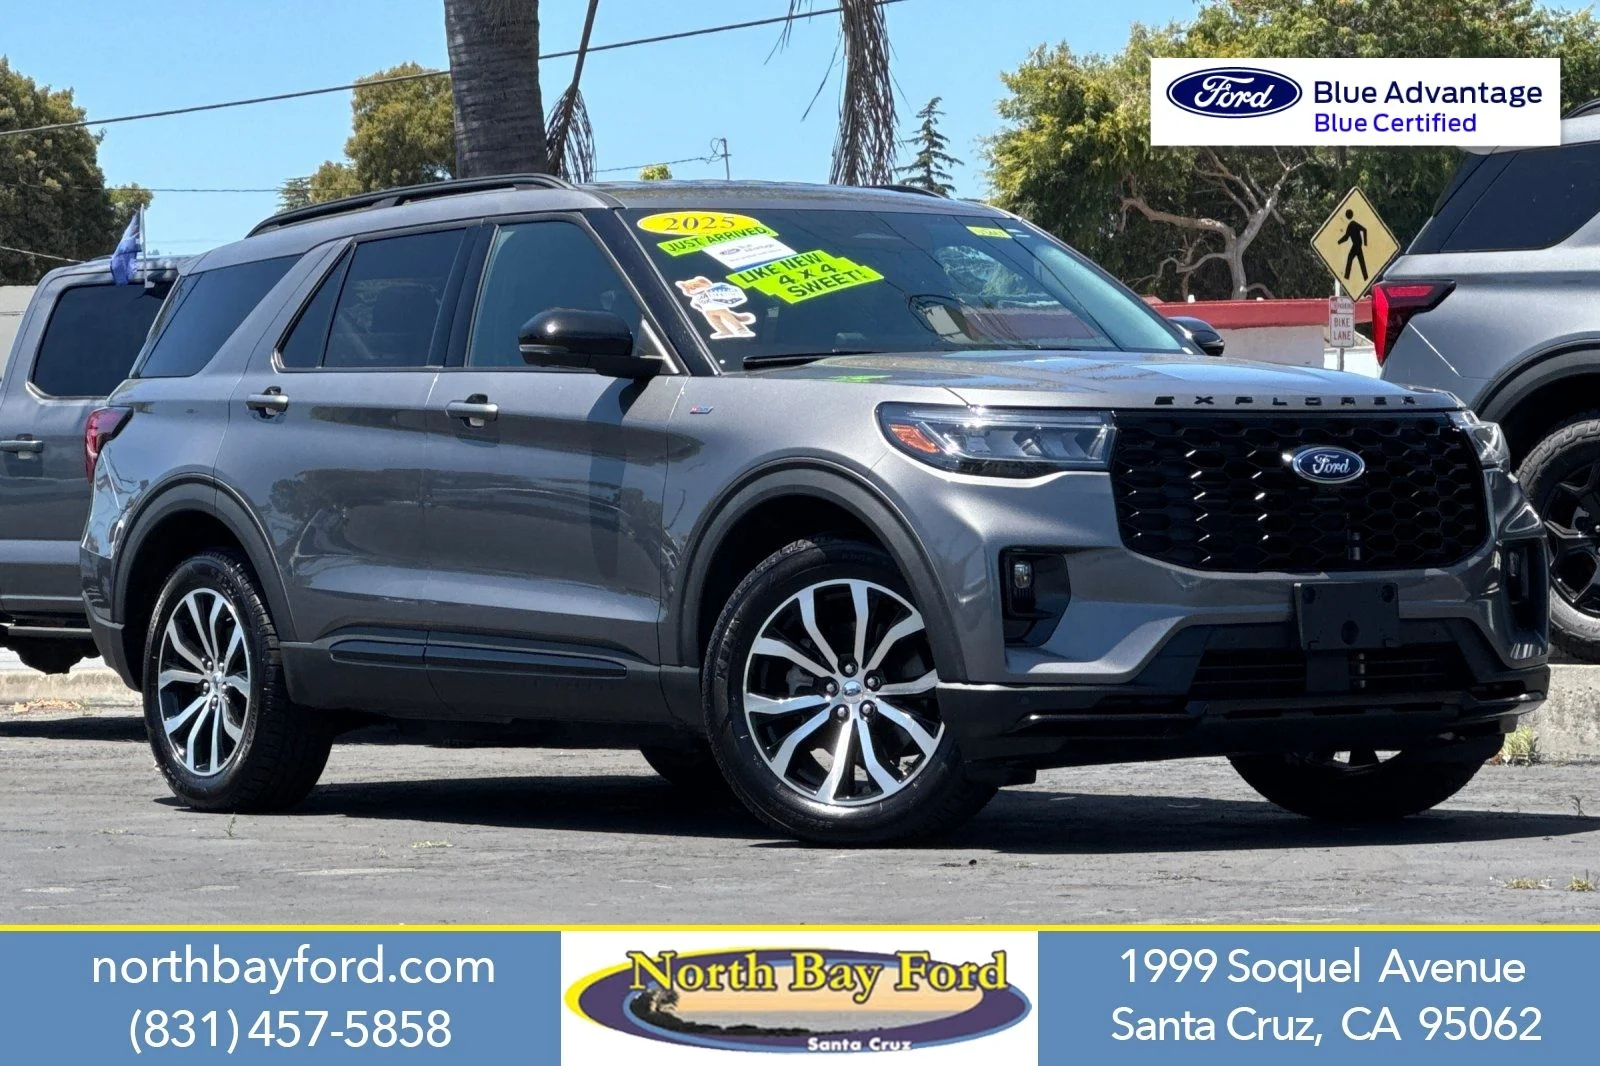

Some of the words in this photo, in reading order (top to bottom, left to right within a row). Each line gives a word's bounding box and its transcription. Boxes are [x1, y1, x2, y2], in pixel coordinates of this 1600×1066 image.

[664, 216, 735, 230] 2025
[668, 238, 701, 251] JUST
[738, 264, 779, 283] LIKE
[780, 252, 822, 270] NEW
[778, 274, 796, 285] 4
[820, 263, 837, 273] 4
[787, 269, 868, 297] SWEET!
[1334, 317, 1351, 328] BIKE
[1333, 330, 1351, 340] LANE
[1154, 396, 1416, 406] EXPLORER
[1312, 454, 1351, 474] Ford
